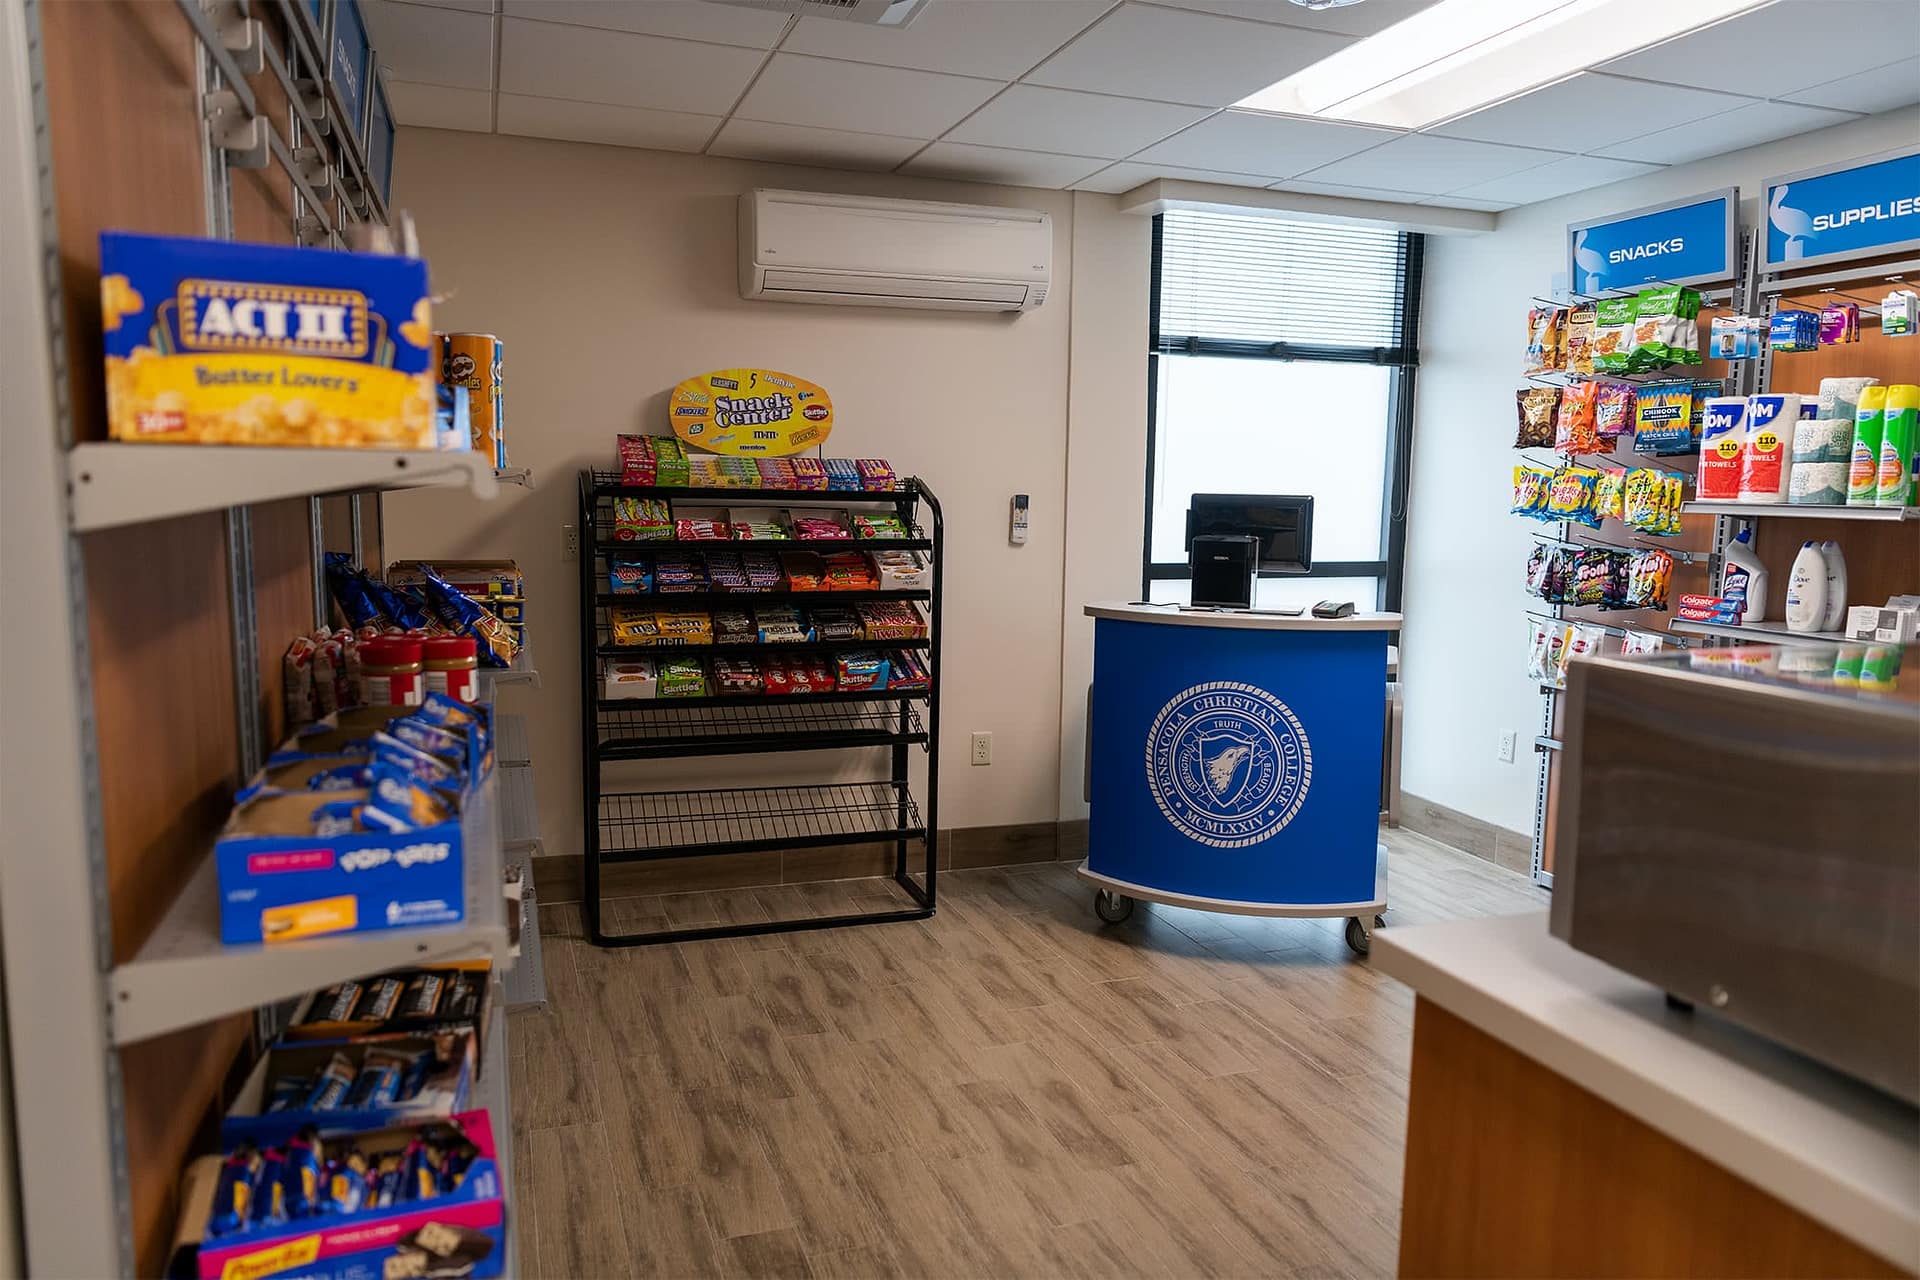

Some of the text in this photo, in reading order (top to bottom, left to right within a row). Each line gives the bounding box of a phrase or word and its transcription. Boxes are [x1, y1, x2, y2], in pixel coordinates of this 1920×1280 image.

[1608, 237, 1684, 264] SNACKS
[200, 298, 347, 341] ACT II
[194, 366, 359, 393] Butter Lovers
[749, 372, 758, 389] 5
[715, 393, 793, 415] Snack
[1643, 407, 1679, 416] CHINOOK
[715, 407, 793, 428] Center
[1719, 443, 1737, 451] 110
[1758, 436, 1777, 445] 110
[1681, 595, 1714, 606] Colgate
[1679, 607, 1711, 618] Colgate
[663, 681, 700, 694] Skittles
[839, 674, 873, 685] Skittles
[1213, 719, 1242, 731] TRUTH
[1158, 695, 1298, 808] PENSACOLA CHRISTIAN COLLEGE
[1257, 761, 1273, 794] BEAUTY
[1183, 809, 1266, 835] MCMLXXIV
